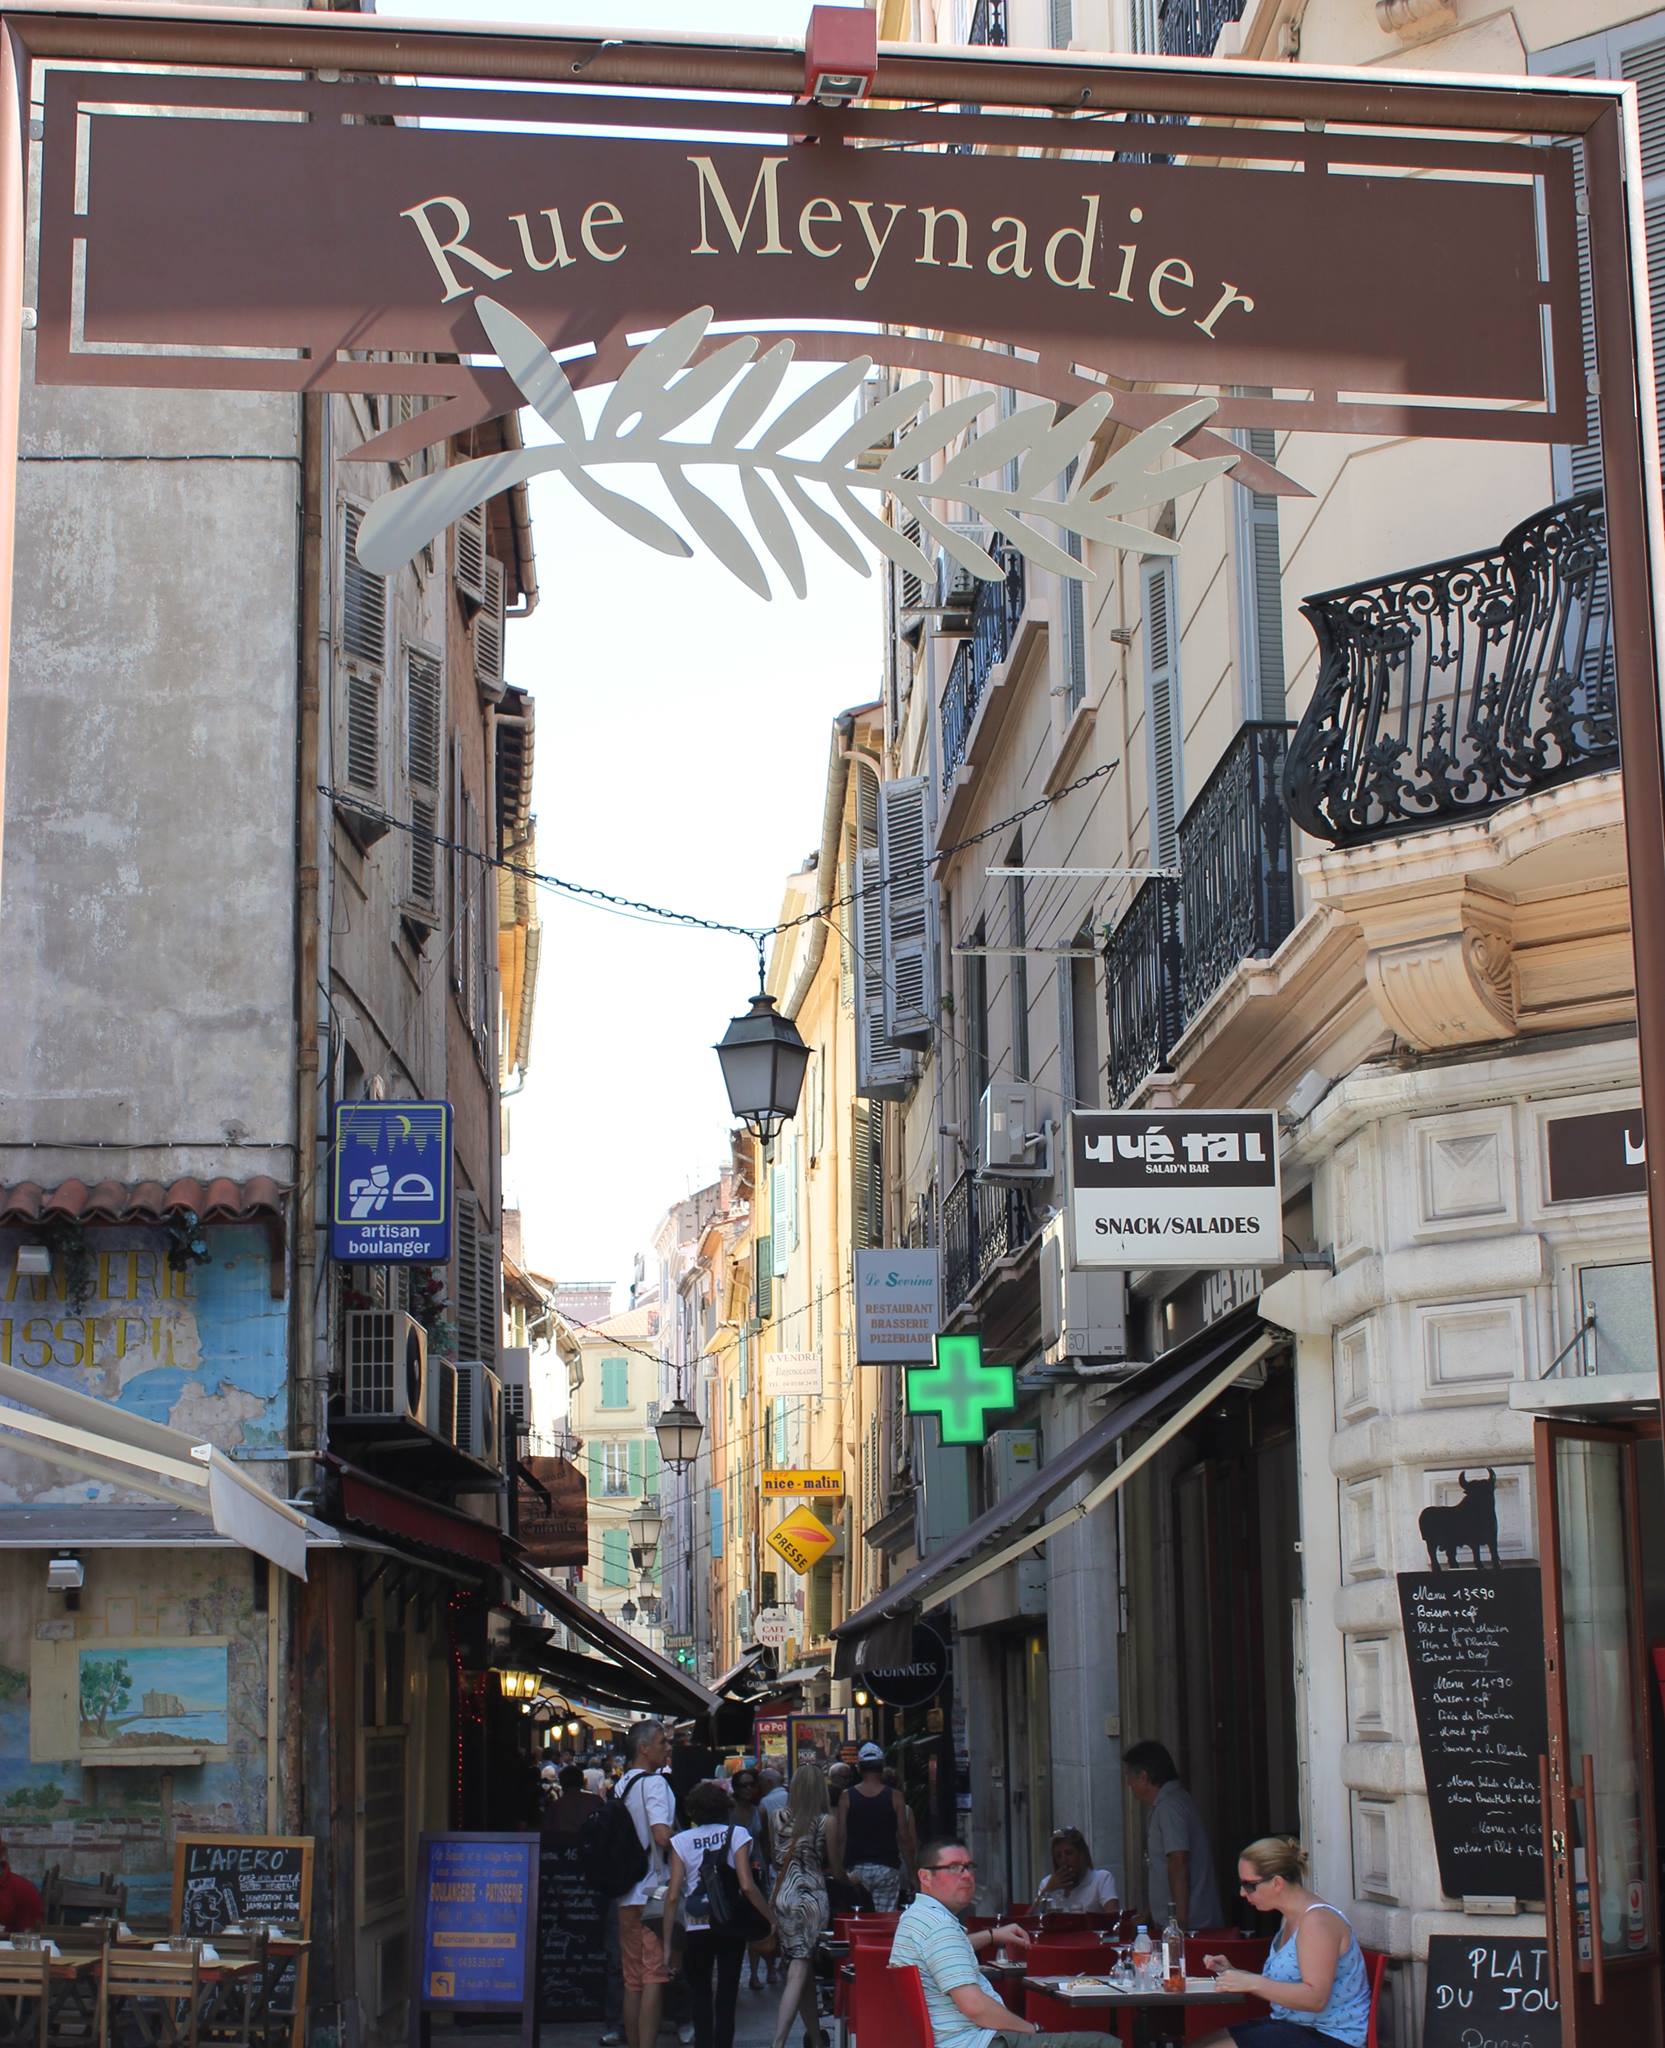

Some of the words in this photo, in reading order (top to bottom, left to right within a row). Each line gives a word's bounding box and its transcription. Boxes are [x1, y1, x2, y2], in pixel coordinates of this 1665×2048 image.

[400, 194, 629, 305] Rue
[687, 155, 1257, 340] Meynadier
[1189, 1164, 1210, 1173] BAR
[361, 1224, 420, 1238] artisan
[1095, 1216, 1260, 1235] SNACK/SALADES
[349, 1241, 431, 1257] boulanger
[865, 1303, 934, 1314] RESTAURANT
[871, 1318, 929, 1329] BRASSERIE
[772, 1532, 808, 1570] PRESSE
[1412, 1585, 1447, 1601] Menu
[1467, 1946, 1548, 1981] PLAT
[1436, 1985, 1474, 2009] DU
